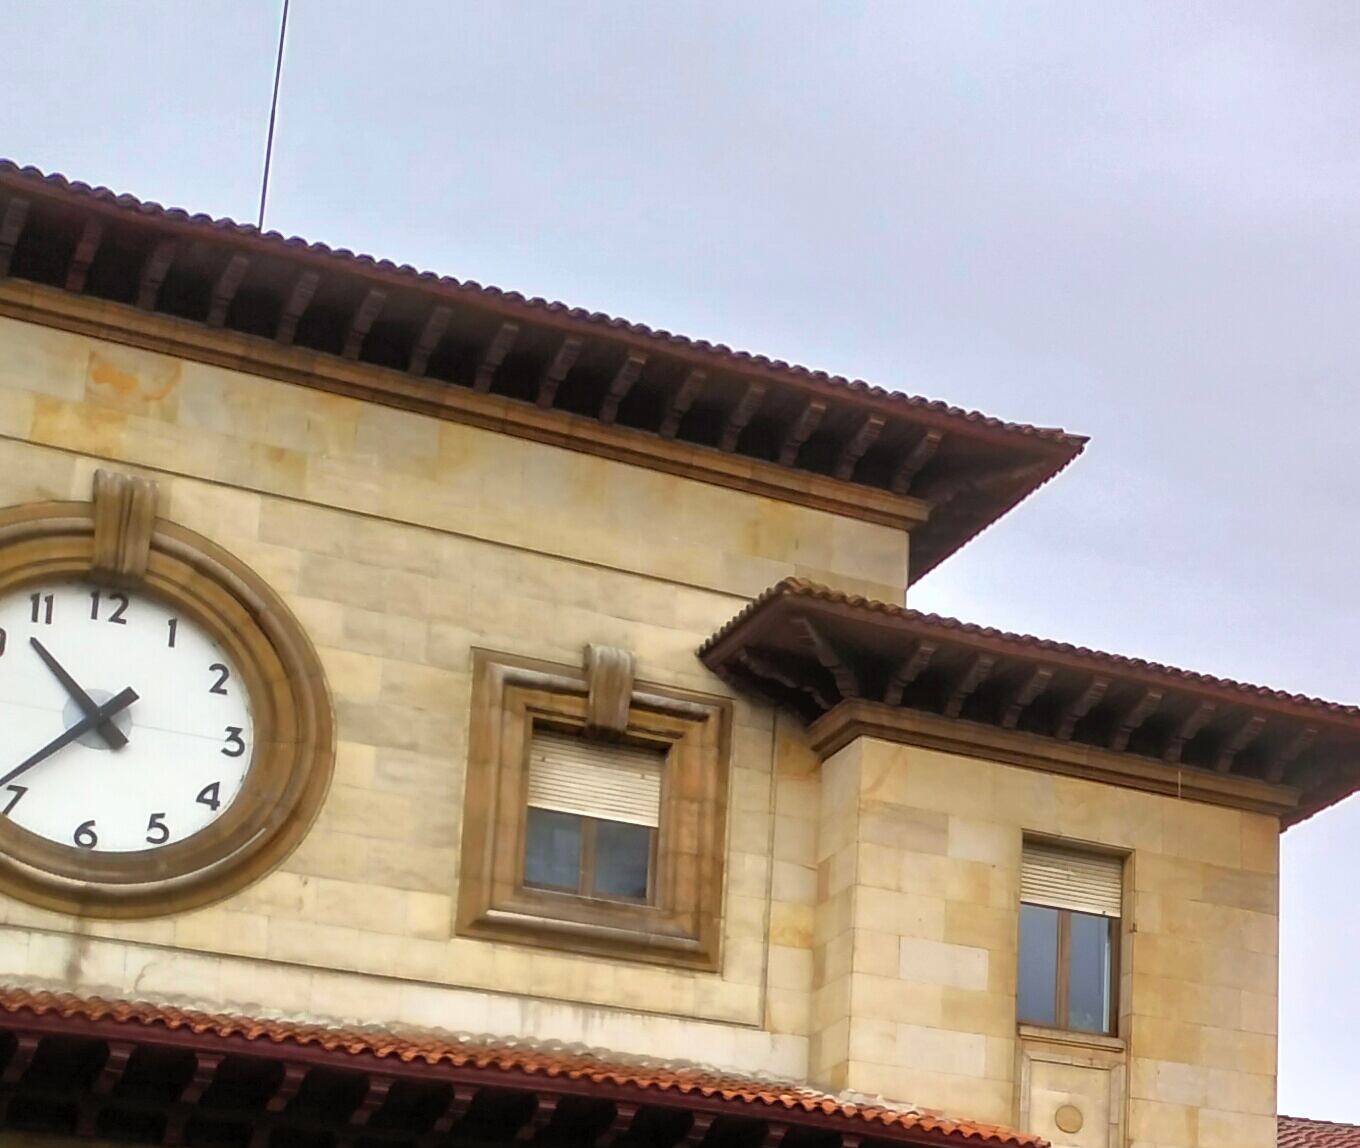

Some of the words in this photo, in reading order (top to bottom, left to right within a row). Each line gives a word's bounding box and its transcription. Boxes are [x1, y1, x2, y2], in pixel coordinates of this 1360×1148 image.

[30, 592, 55, 625] 11
[90, 591, 129, 625] 12
[167, 617, 178, 648] 1
[209, 663, 230, 696] 2
[221, 726, 246, 758] 3
[3, 785, 29, 816] 7
[195, 781, 221, 812] 4
[73, 819, 98, 850] 6
[146, 812, 170, 845] 5
